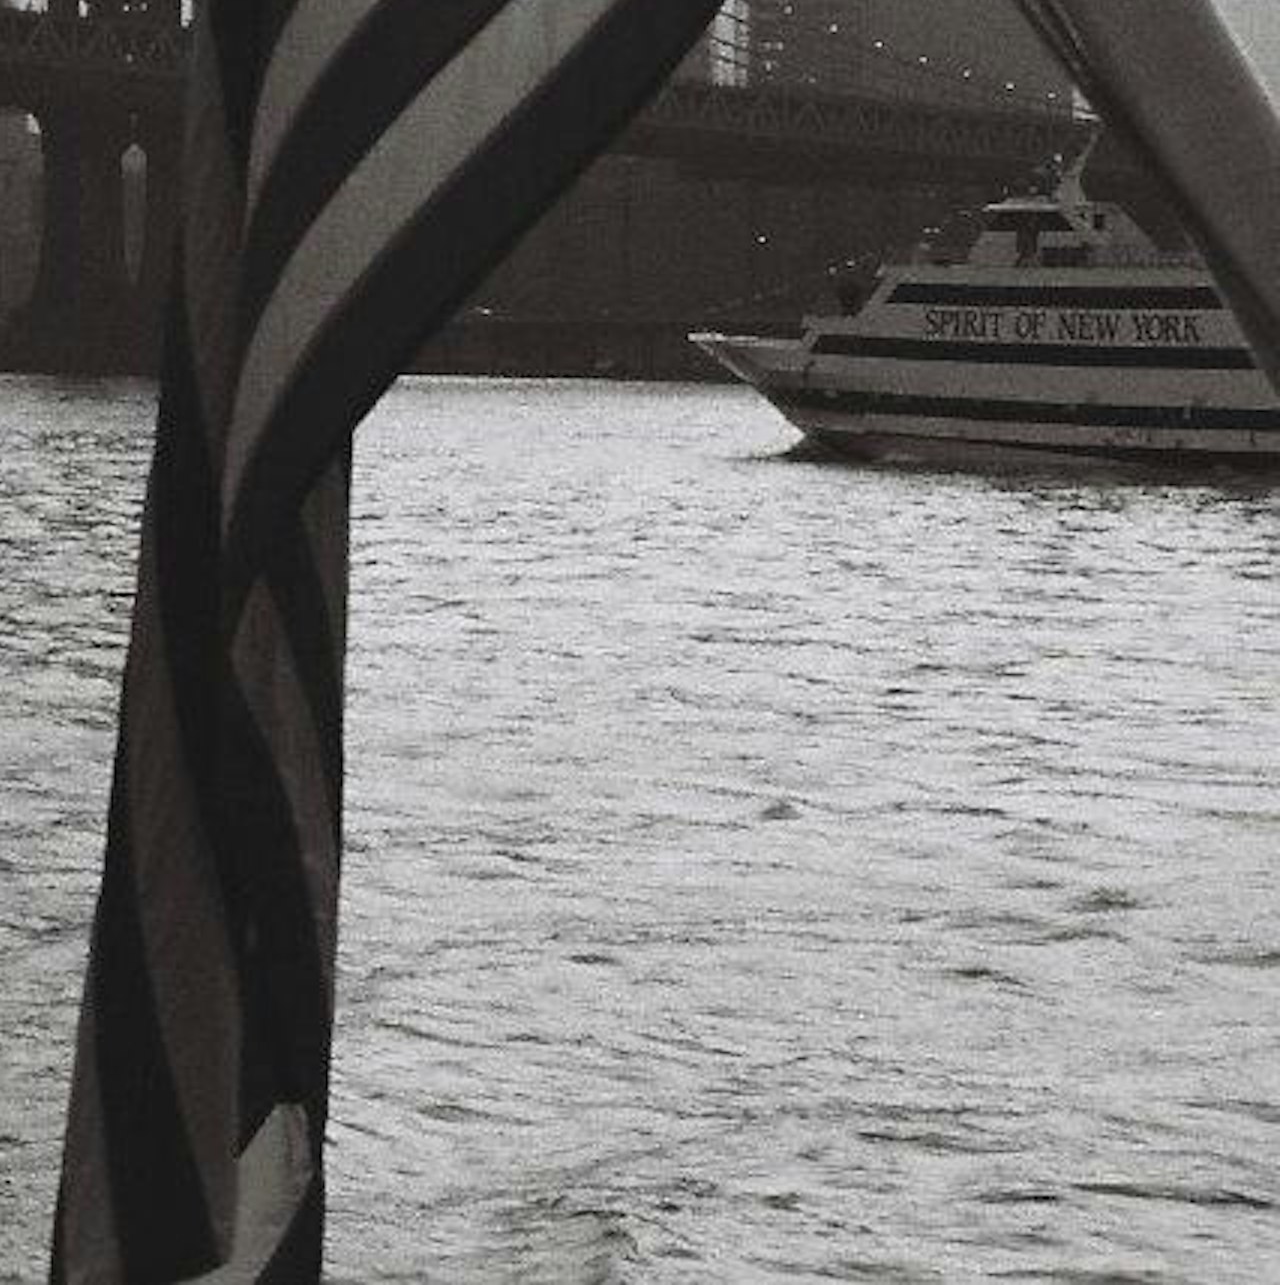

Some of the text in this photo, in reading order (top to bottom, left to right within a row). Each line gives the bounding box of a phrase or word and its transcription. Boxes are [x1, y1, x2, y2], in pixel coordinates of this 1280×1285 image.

[925, 309, 1200, 343] SPIRIT OF NEW YORK
